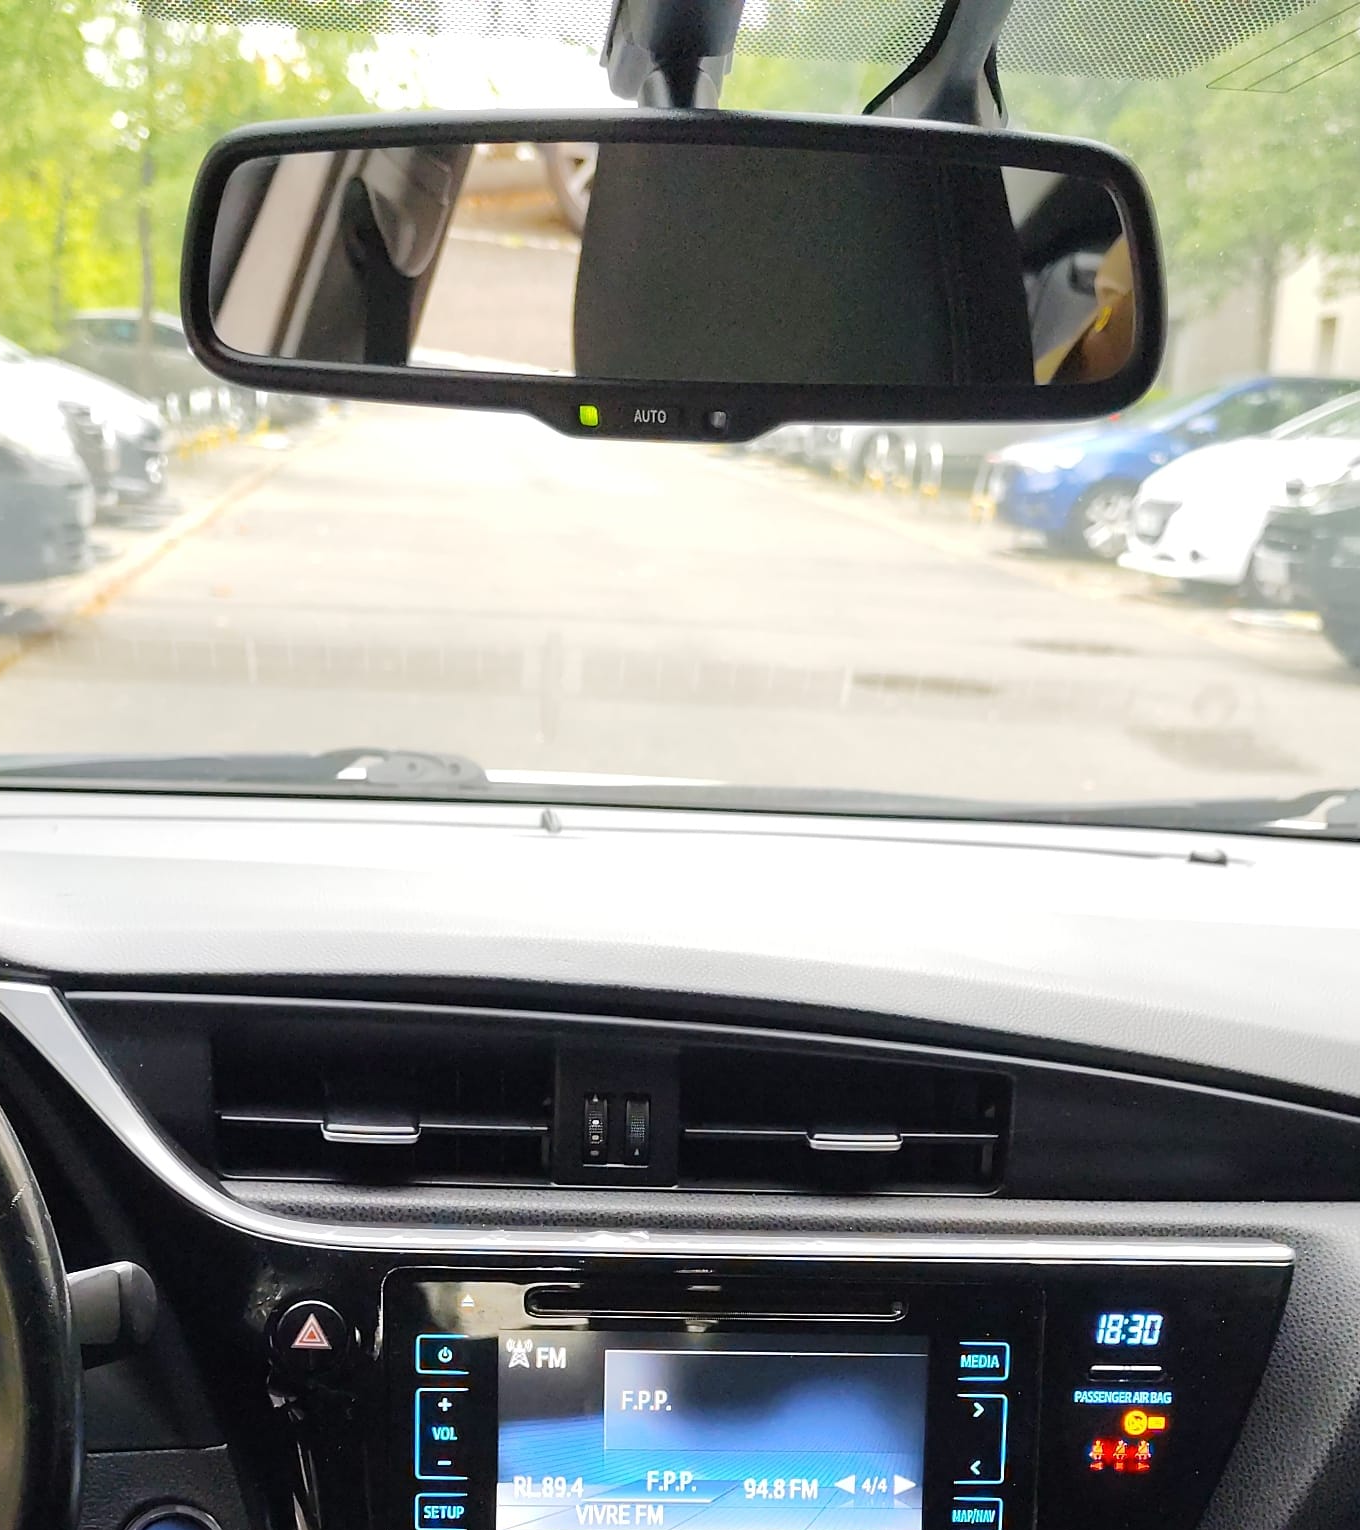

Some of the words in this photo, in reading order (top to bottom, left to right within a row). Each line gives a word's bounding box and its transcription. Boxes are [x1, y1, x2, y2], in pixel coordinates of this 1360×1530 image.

[633, 409, 667, 424] AUTO
[1095, 1314, 1163, 1345] 18:30
[535, 1347, 567, 1369] FM
[960, 1355, 1000, 1369] MEDIA
[620, 1390, 672, 1412] F.P.P.
[1073, 1391, 1132, 1404] PASSENGER
[1132, 1391, 1150, 1404] AIR
[1150, 1391, 1173, 1404] BAG
[431, 1427, 458, 1441] VOL
[646, 1471, 697, 1492] F.P.P.
[743, 1479, 786, 1499] 94.8
[789, 1480, 818, 1499] FM
[862, 1481, 888, 1494] 4/4
[423, 1505, 465, 1520] SETUP
[575, 1504, 630, 1526] VIVRE
[635, 1504, 664, 1526] FM
